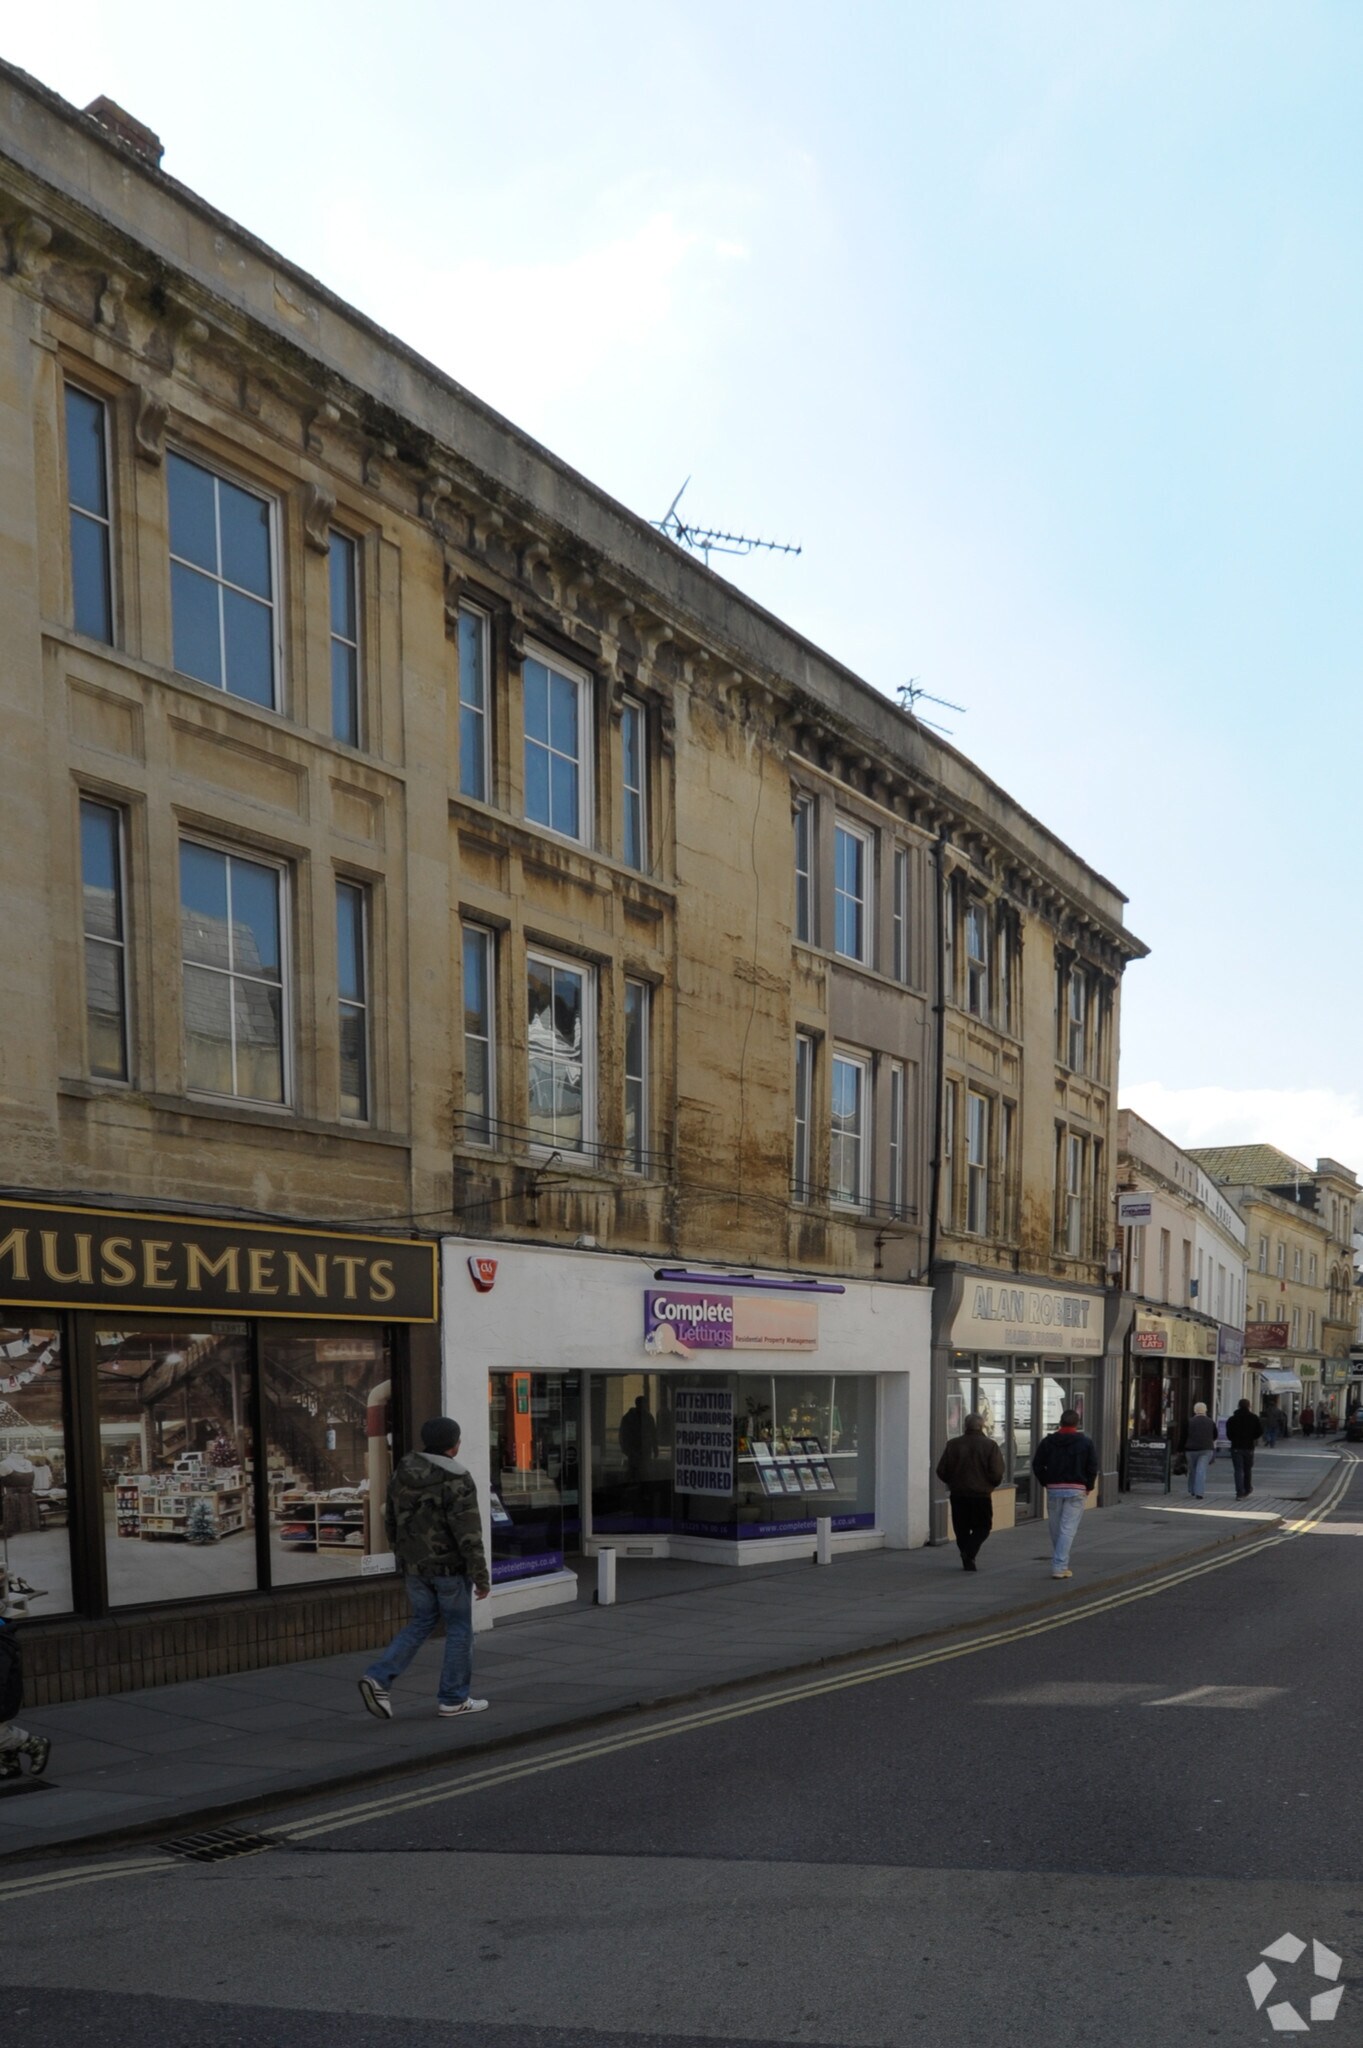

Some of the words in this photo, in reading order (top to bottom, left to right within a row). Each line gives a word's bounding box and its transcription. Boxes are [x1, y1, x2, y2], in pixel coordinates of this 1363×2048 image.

[654, 1297, 733, 1325] Complete
[972, 1286, 1025, 1322] ALAN
[1029, 1293, 1090, 1328] ROBERT
[678, 1323, 733, 1347] Lettings
[735, 1335, 763, 1343] Residential
[764, 1336, 786, 1345] Property
[786, 1337, 817, 1345] Management
[1137, 1334, 1159, 1342] JUST
[323, 1342, 375, 1356] SALE
[676, 1392, 732, 1410] ATTENTION
[676, 1411, 688, 1424] ALL
[689, 1411, 732, 1425] LANDLORDS
[676, 1430, 732, 1447] PROPERTIES
[676, 1448, 732, 1469] URGENTLY
[676, 1469, 732, 1490] REQUIRED
[759, 1517, 857, 1533] www.completeles.co.uk
